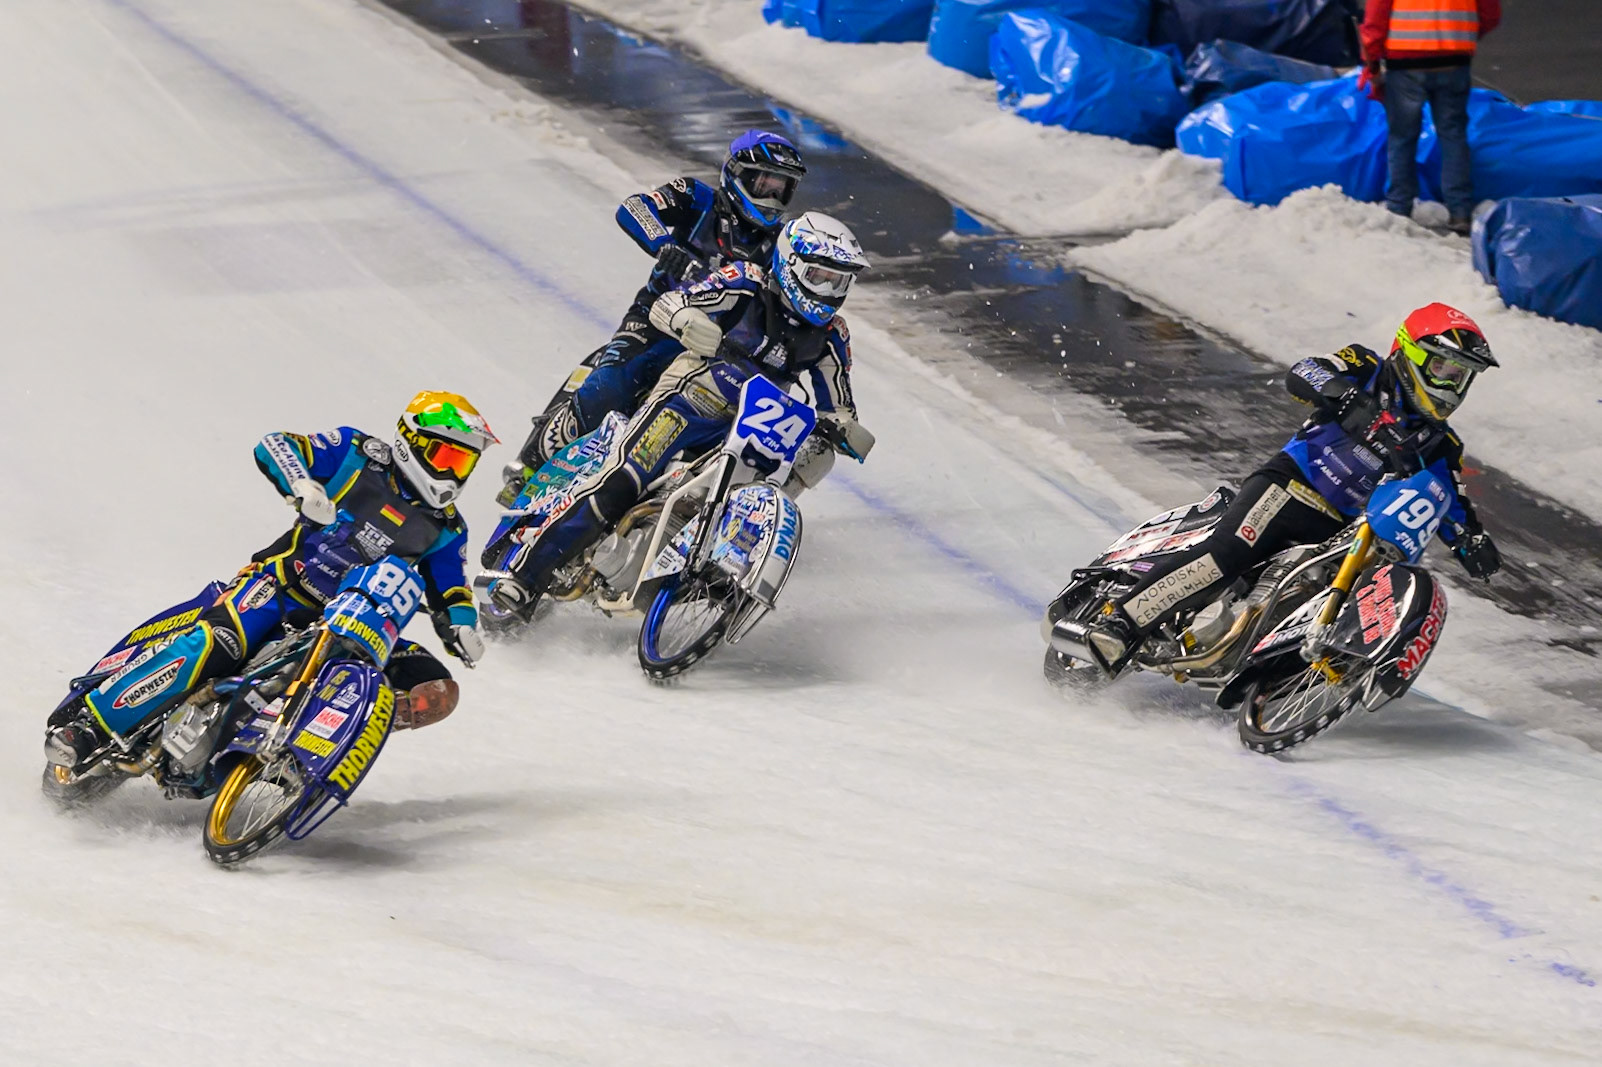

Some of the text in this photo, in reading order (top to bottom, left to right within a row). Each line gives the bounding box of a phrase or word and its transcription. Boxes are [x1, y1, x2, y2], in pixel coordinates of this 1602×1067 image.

[725, 372, 743, 388] ANLA
[742, 398, 807, 449] 24
[764, 436, 780, 450] FIM
[1321, 465, 1342, 485] ANLAS
[1397, 532, 1418, 556] FIM
[367, 562, 422, 616] 85
[1136, 560, 1206, 609] NORDISKA
[1136, 568, 1221, 627] CENTRUMHUS
[125, 606, 203, 646] THORWESTEN
[213, 628, 241, 659] ORTEMA
[110, 653, 148, 684] GRUBER
[123, 666, 178, 704] THORWESTEN
[328, 683, 395, 792] THORWESTEN
